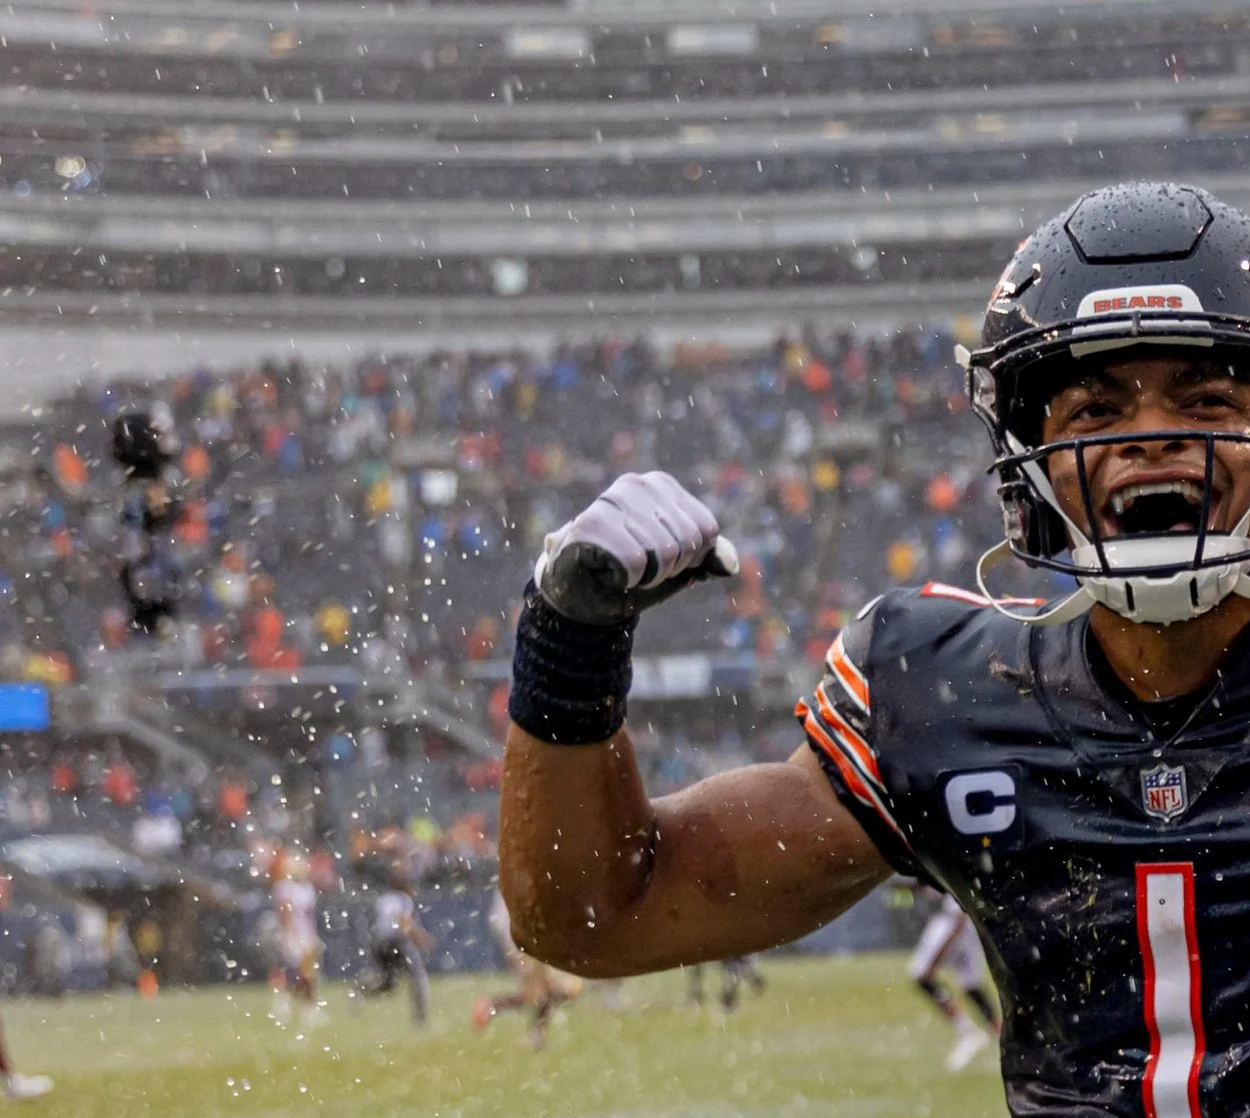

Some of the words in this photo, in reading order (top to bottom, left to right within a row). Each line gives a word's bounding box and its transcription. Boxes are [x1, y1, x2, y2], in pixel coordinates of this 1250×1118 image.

[1093, 295, 1183, 313] BEARS
[943, 770, 1016, 835] C
[1149, 787, 1181, 811] NFL
